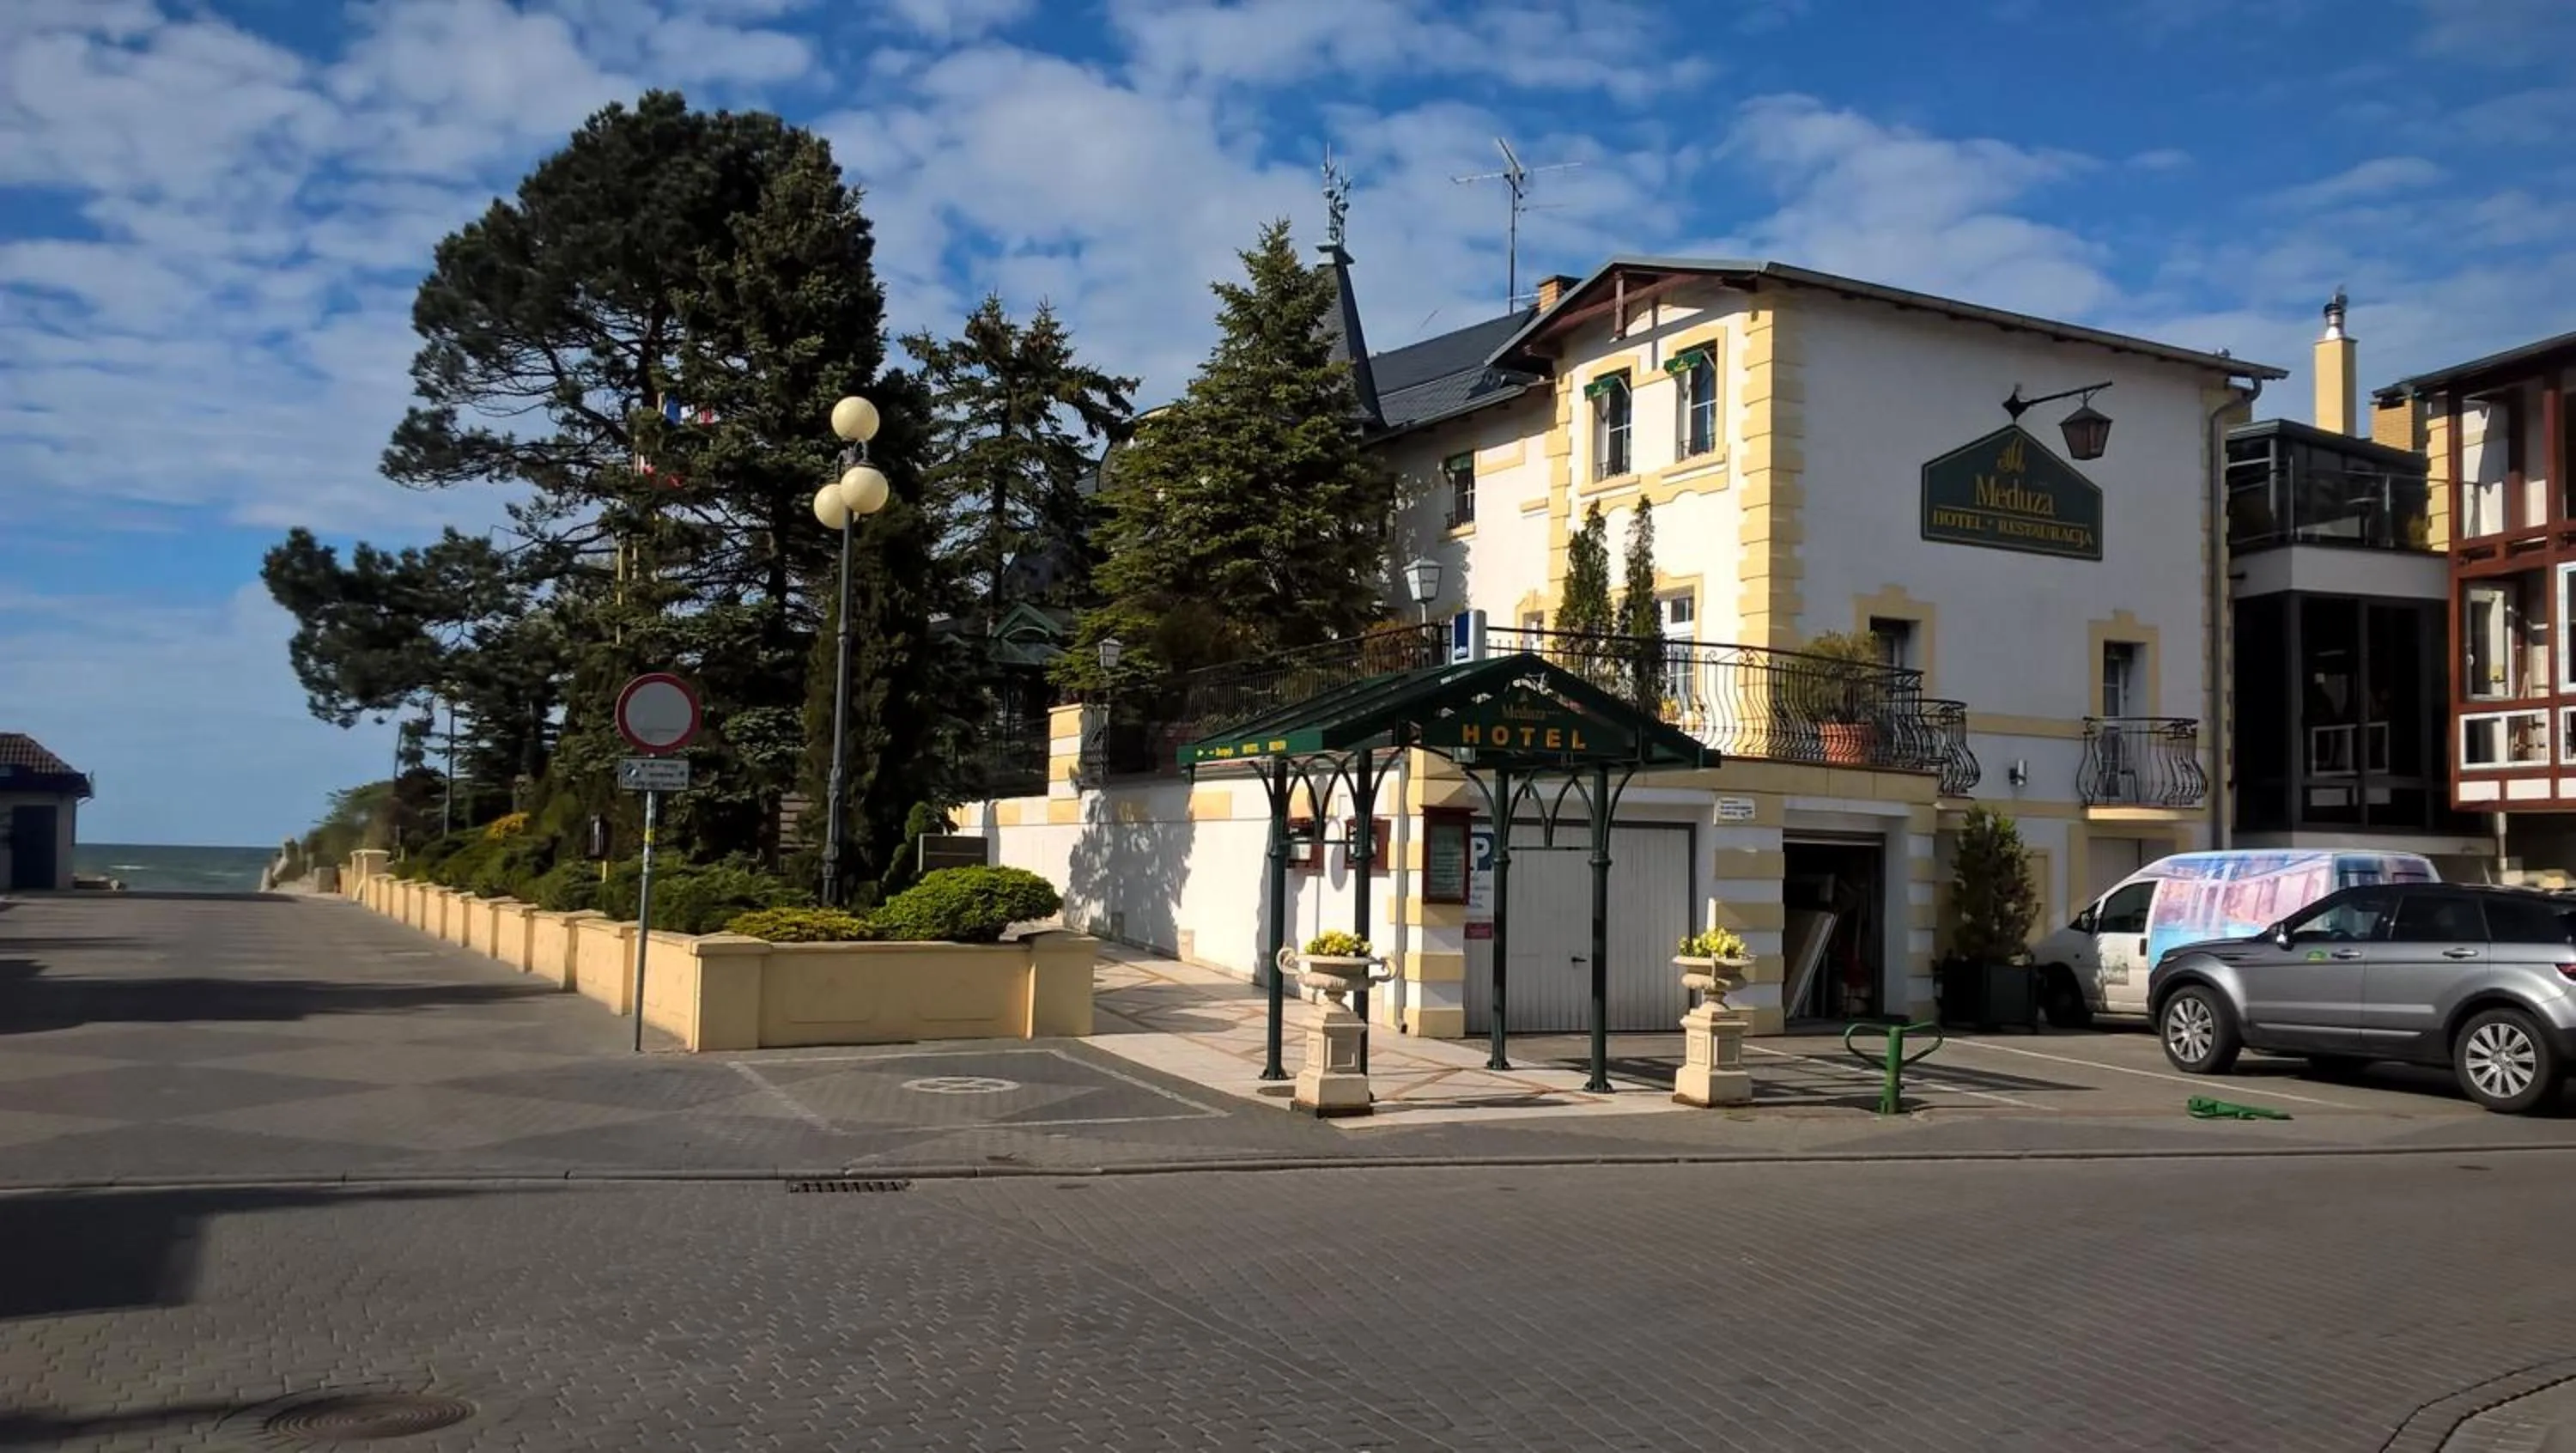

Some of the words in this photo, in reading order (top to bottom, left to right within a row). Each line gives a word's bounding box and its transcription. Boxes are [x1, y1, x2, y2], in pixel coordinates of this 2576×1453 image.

[1975, 474, 2054, 515] Meduza
[1933, 509, 1984, 530] HOTEL
[1998, 519, 2093, 548] RESTAURACJA
[1462, 724, 1587, 750] HOTEL
